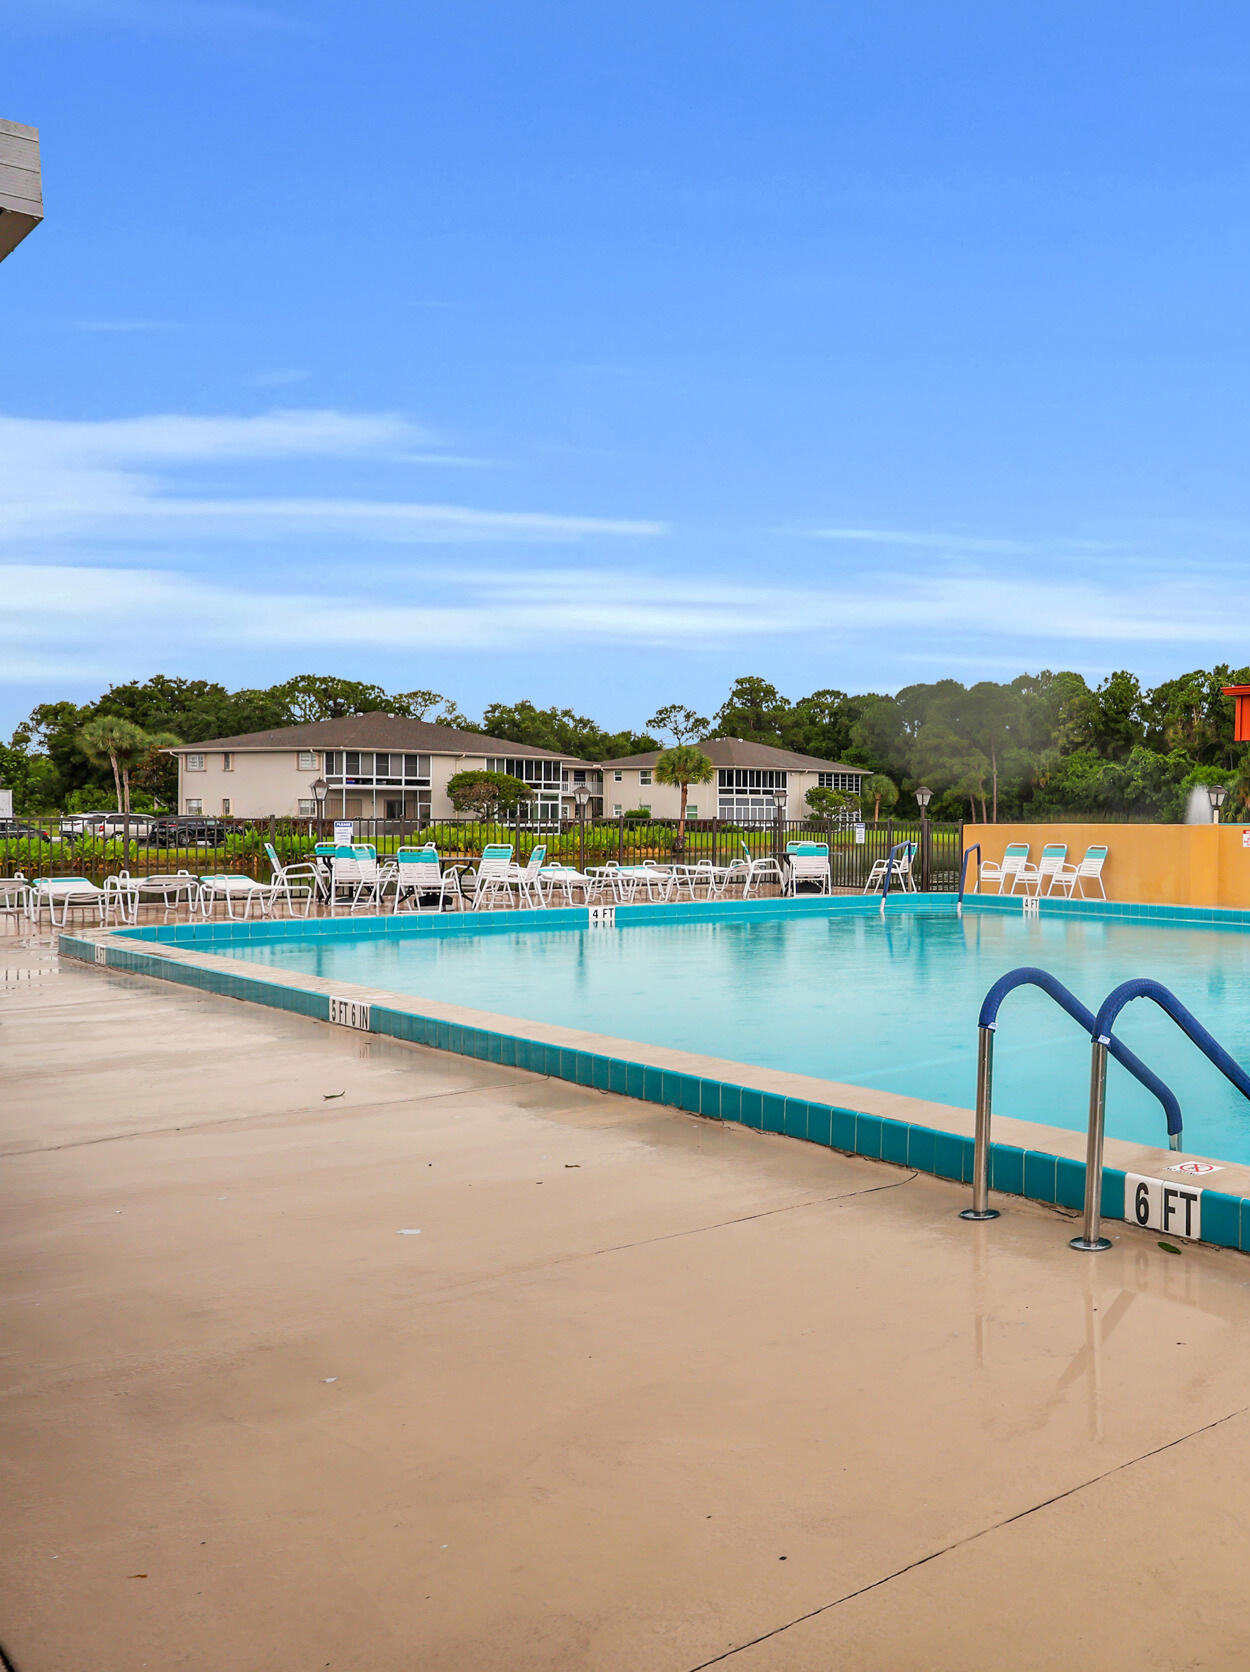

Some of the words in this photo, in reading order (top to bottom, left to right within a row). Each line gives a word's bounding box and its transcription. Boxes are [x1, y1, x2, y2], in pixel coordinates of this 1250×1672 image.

[593, 909, 599, 919] 4
[603, 908, 614, 919] FT
[332, 999, 337, 1021] 5
[339, 1001, 349, 1025] FT
[351, 1003, 356, 1026] 6
[359, 1004, 368, 1029] IN
[1135, 1182, 1149, 1225] 6
[1164, 1187, 1198, 1237] FT
